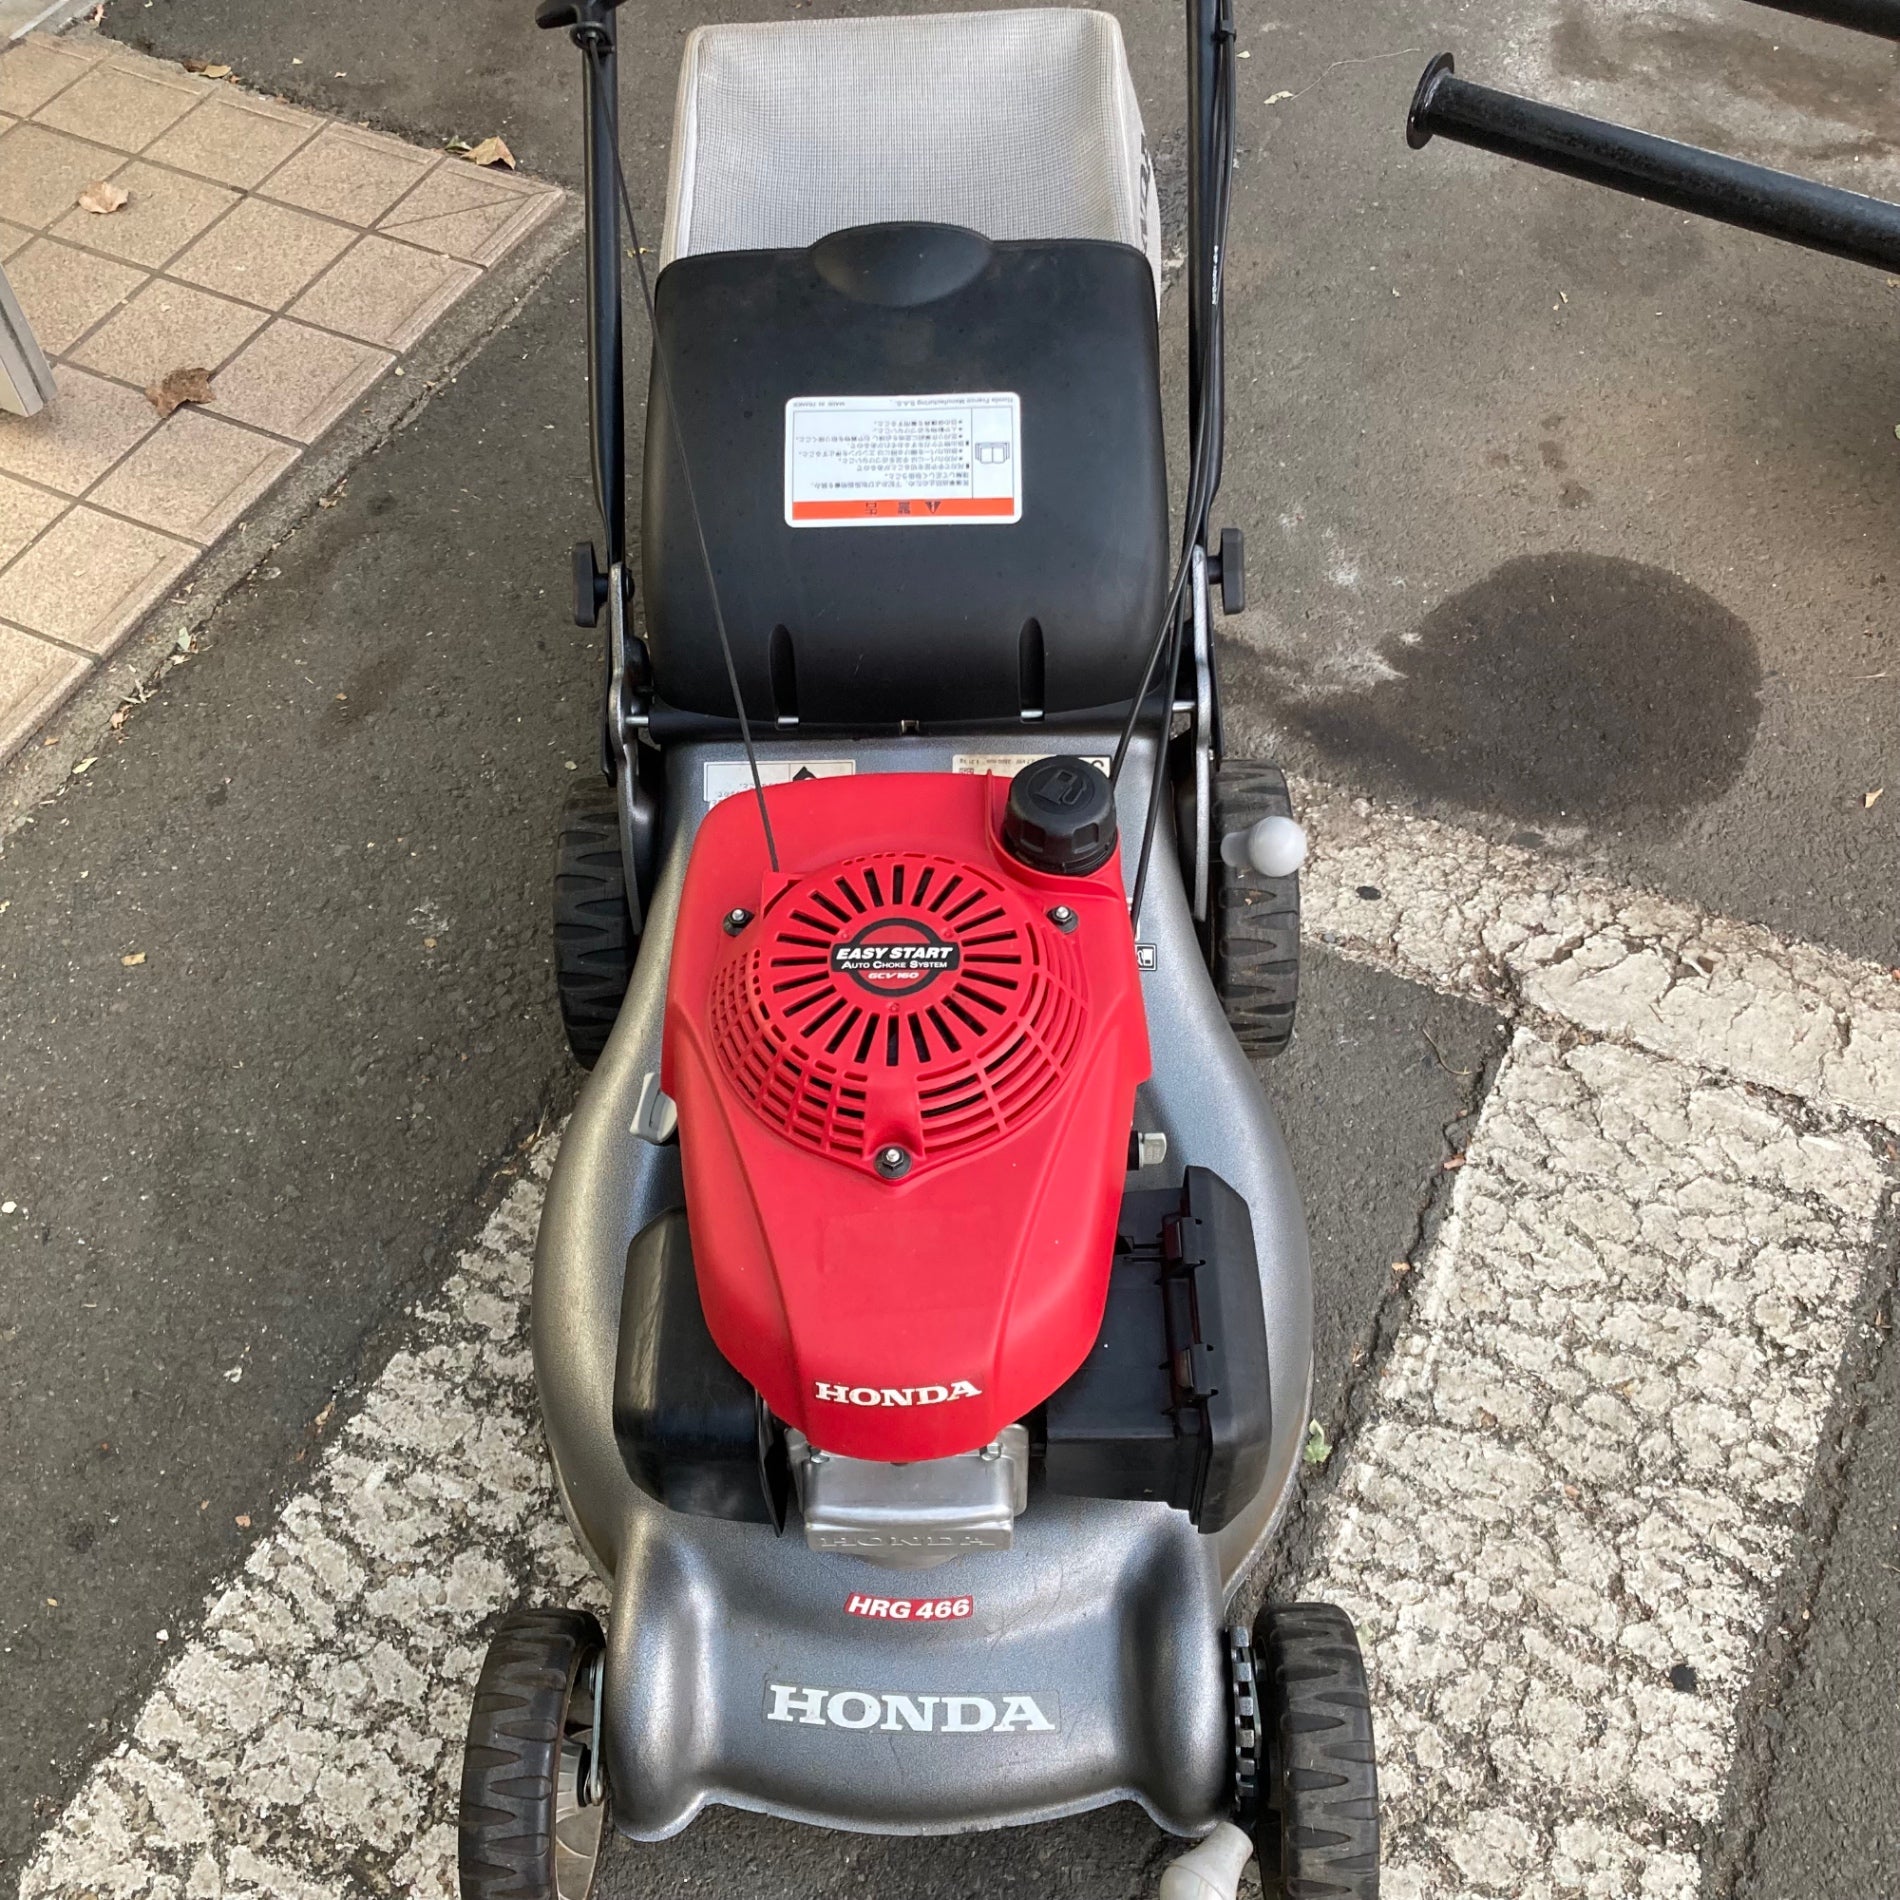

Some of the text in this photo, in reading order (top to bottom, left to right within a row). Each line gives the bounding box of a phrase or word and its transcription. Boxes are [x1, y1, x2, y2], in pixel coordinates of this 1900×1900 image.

[836, 947, 953, 960] EASY START
[815, 1380, 982, 1407] HONDA
[820, 1535, 996, 1548] HONDA
[848, 1595, 970, 1618] HRG 466
[767, 1684, 1056, 1732] HONDA
